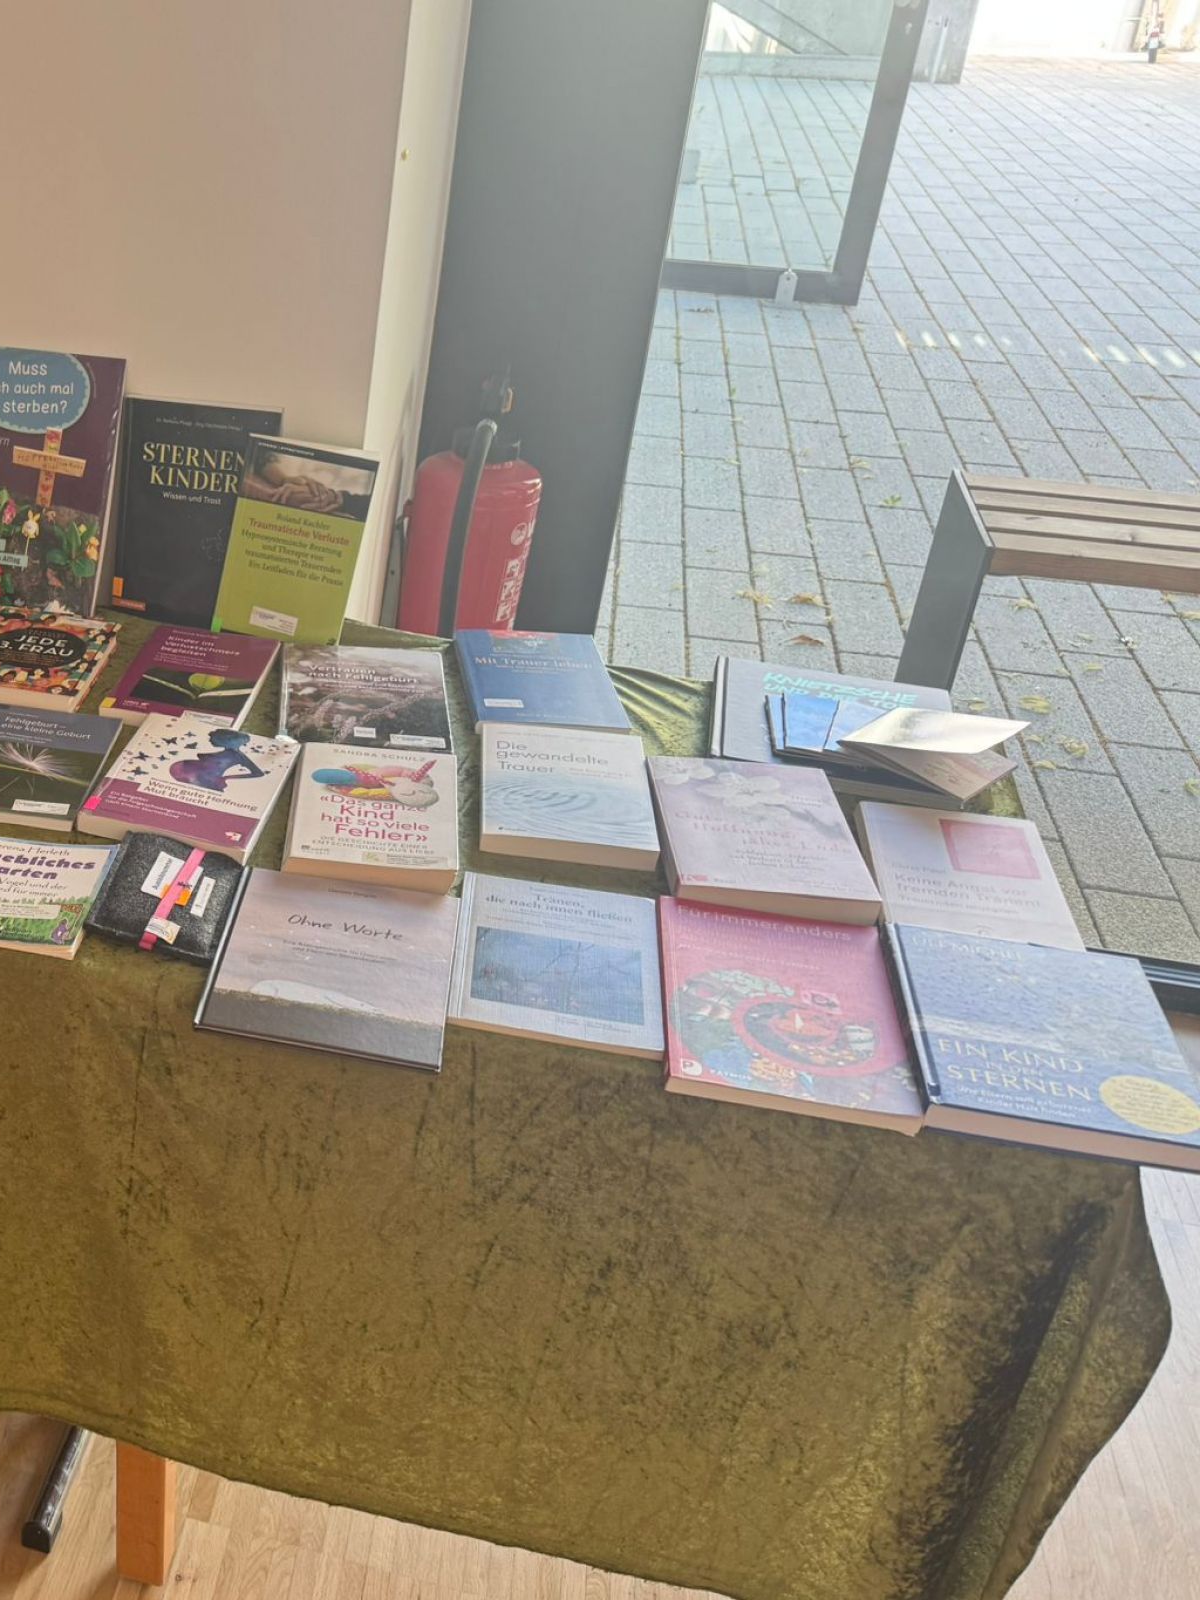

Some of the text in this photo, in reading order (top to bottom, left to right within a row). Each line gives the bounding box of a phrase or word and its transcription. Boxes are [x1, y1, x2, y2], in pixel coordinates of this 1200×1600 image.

[8, 360, 48, 377] Muss
[13, 382, 46, 396] auch
[49, 381, 75, 396] mal
[1, 400, 69, 415] sterben?
[150, 465, 239, 495] KINDER
[163, 491, 222, 506] Wissen und Trost
[249, 517, 351, 547] Traumatische Verluste
[14, 634, 69, 649] JEDE
[17, 644, 75, 658] FRAU
[5, 716, 58, 730] Fehlgeburt
[496, 740, 529, 751] Die
[496, 750, 609, 766] gewandelte
[498, 760, 554, 773] Trauer
[143, 786, 168, 797] Mut
[168, 791, 210, 806] braucht
[149, 780, 179, 792] Wenn
[206, 794, 259, 812] Hoffnung
[340, 804, 396, 821] Kind
[371, 801, 428, 813] ganze
[320, 812, 431, 832] hat so viele
[334, 823, 428, 843] Fehler»
[287, 913, 404, 942] Ohne Worte
[784, 923, 852, 941] anders
[938, 1037, 1084, 1074] EIN KIND
[946, 1063, 1093, 1103] STERNEN
